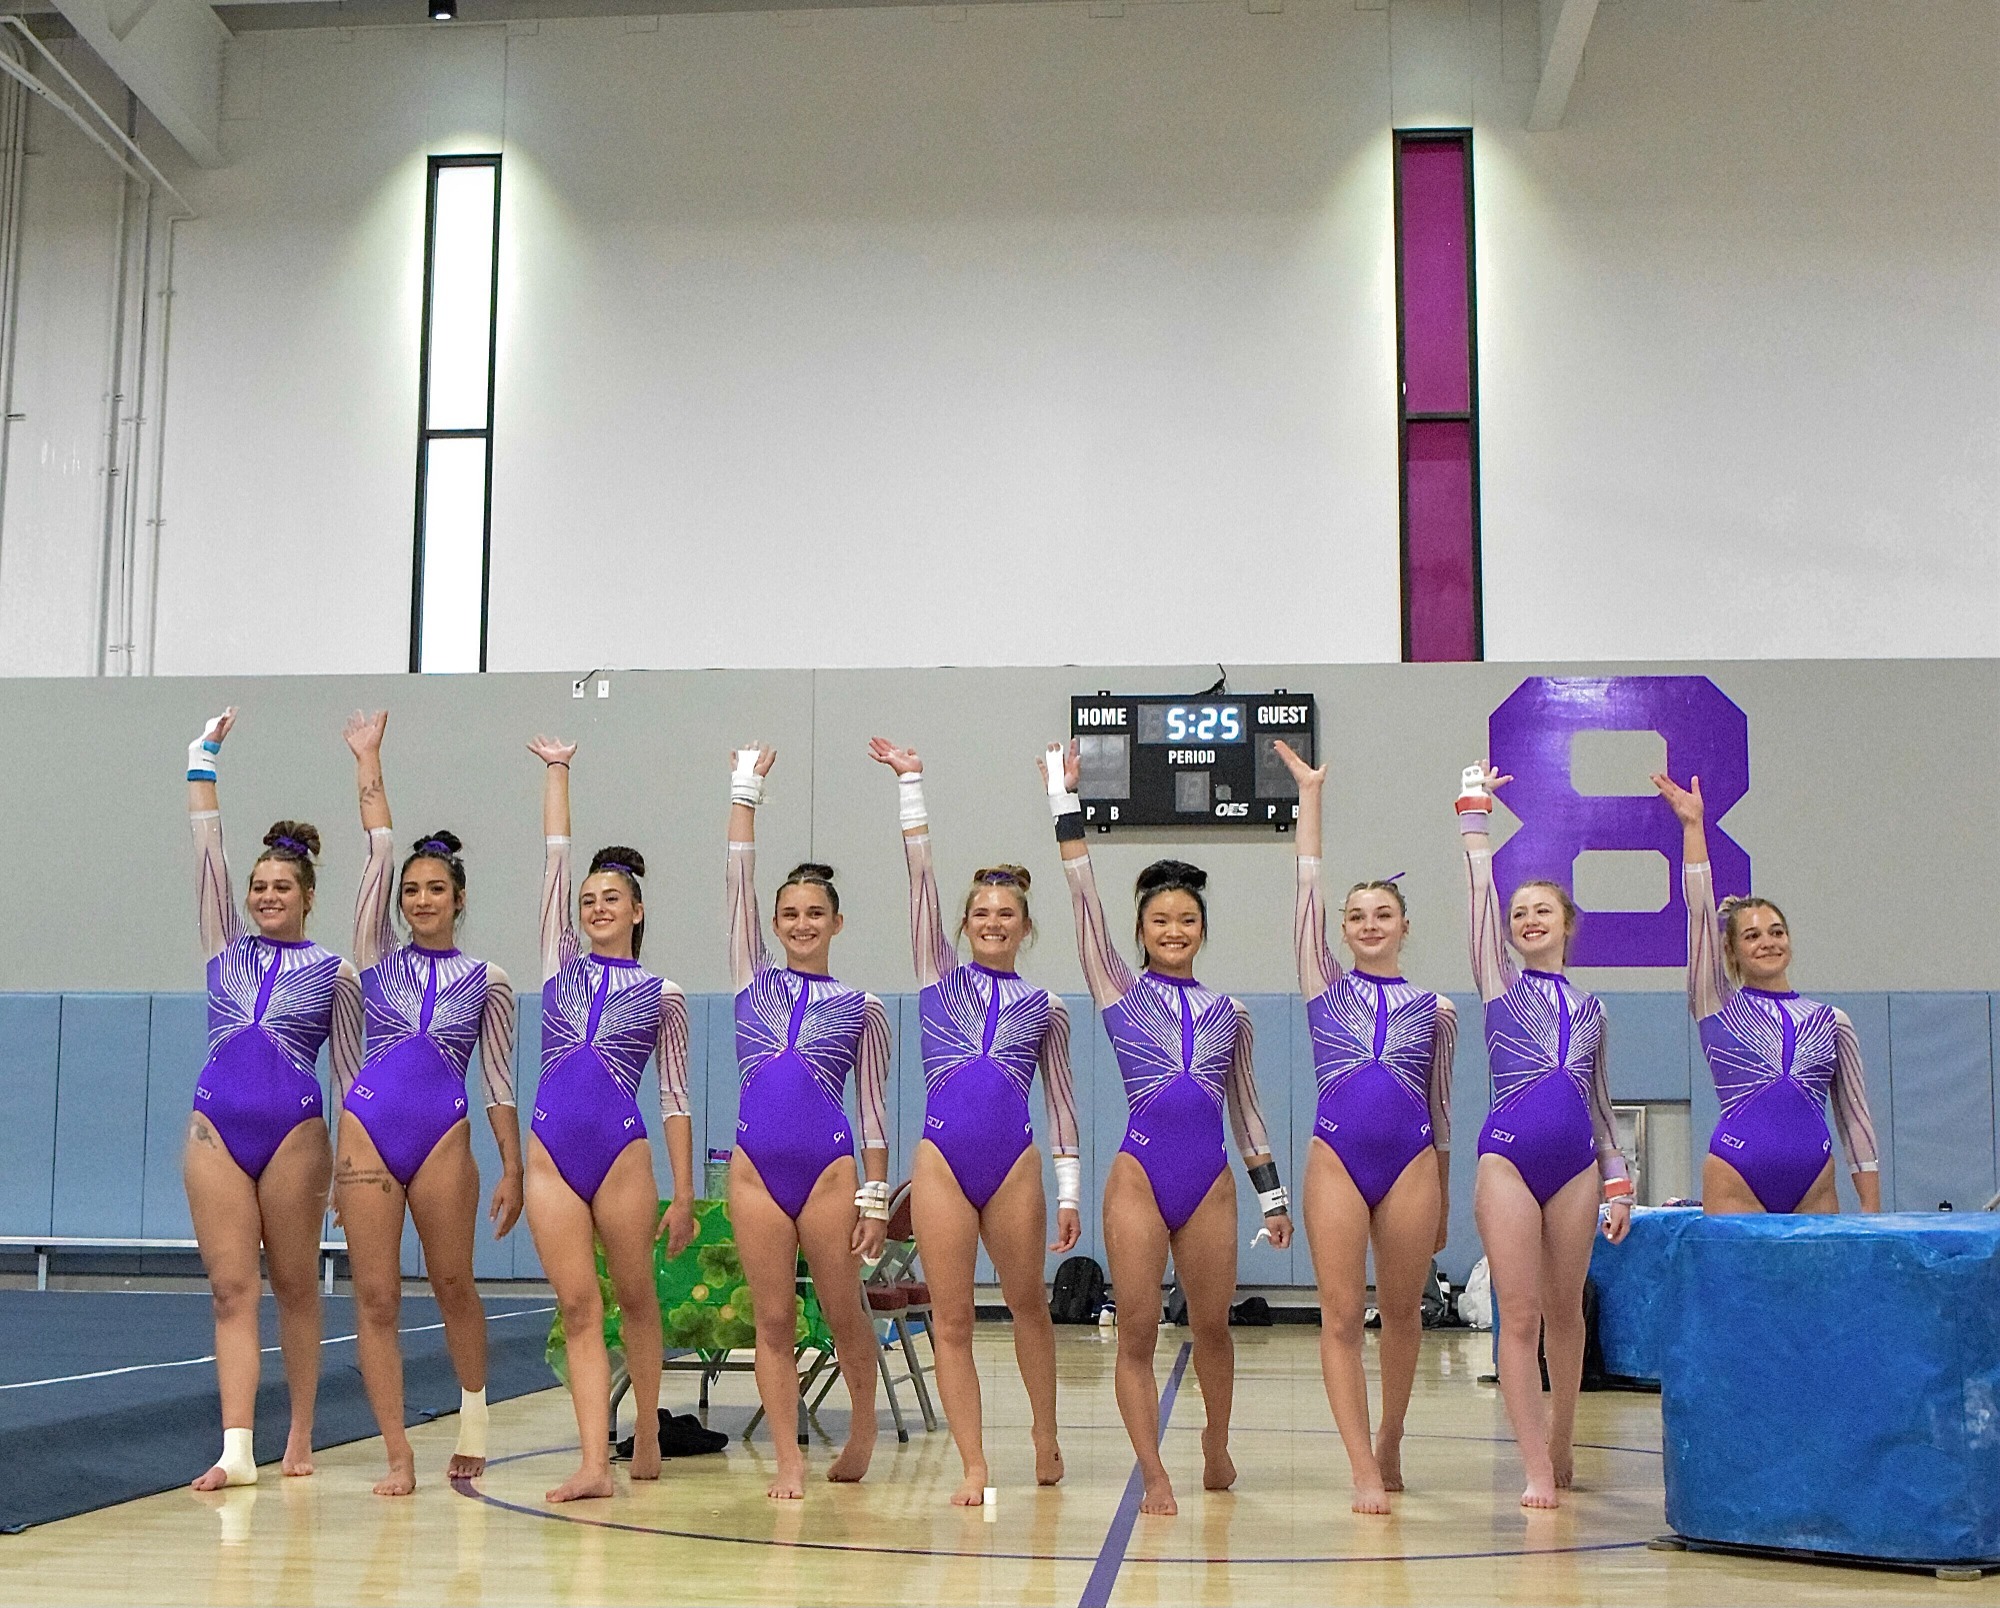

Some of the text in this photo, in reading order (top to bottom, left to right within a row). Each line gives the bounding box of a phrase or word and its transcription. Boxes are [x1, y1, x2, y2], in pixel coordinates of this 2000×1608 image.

[1077, 707, 1127, 726] HOME
[1166, 706, 1240, 740] 5:25
[1257, 705, 1308, 724] GUEST
[1168, 750, 1216, 764] PERIOD
[1086, 806, 1120, 820] P B
[1215, 803, 1249, 817] OES
[1267, 805, 1277, 819] P
[1489, 676, 1751, 966] 8
[353, 1084, 375, 1100] GCU
[1318, 1115, 1339, 1132] GCU
[1129, 1128, 1151, 1146] GCU
[1490, 1128, 1516, 1143] GCU
[1720, 1132, 1746, 1149] GCU
